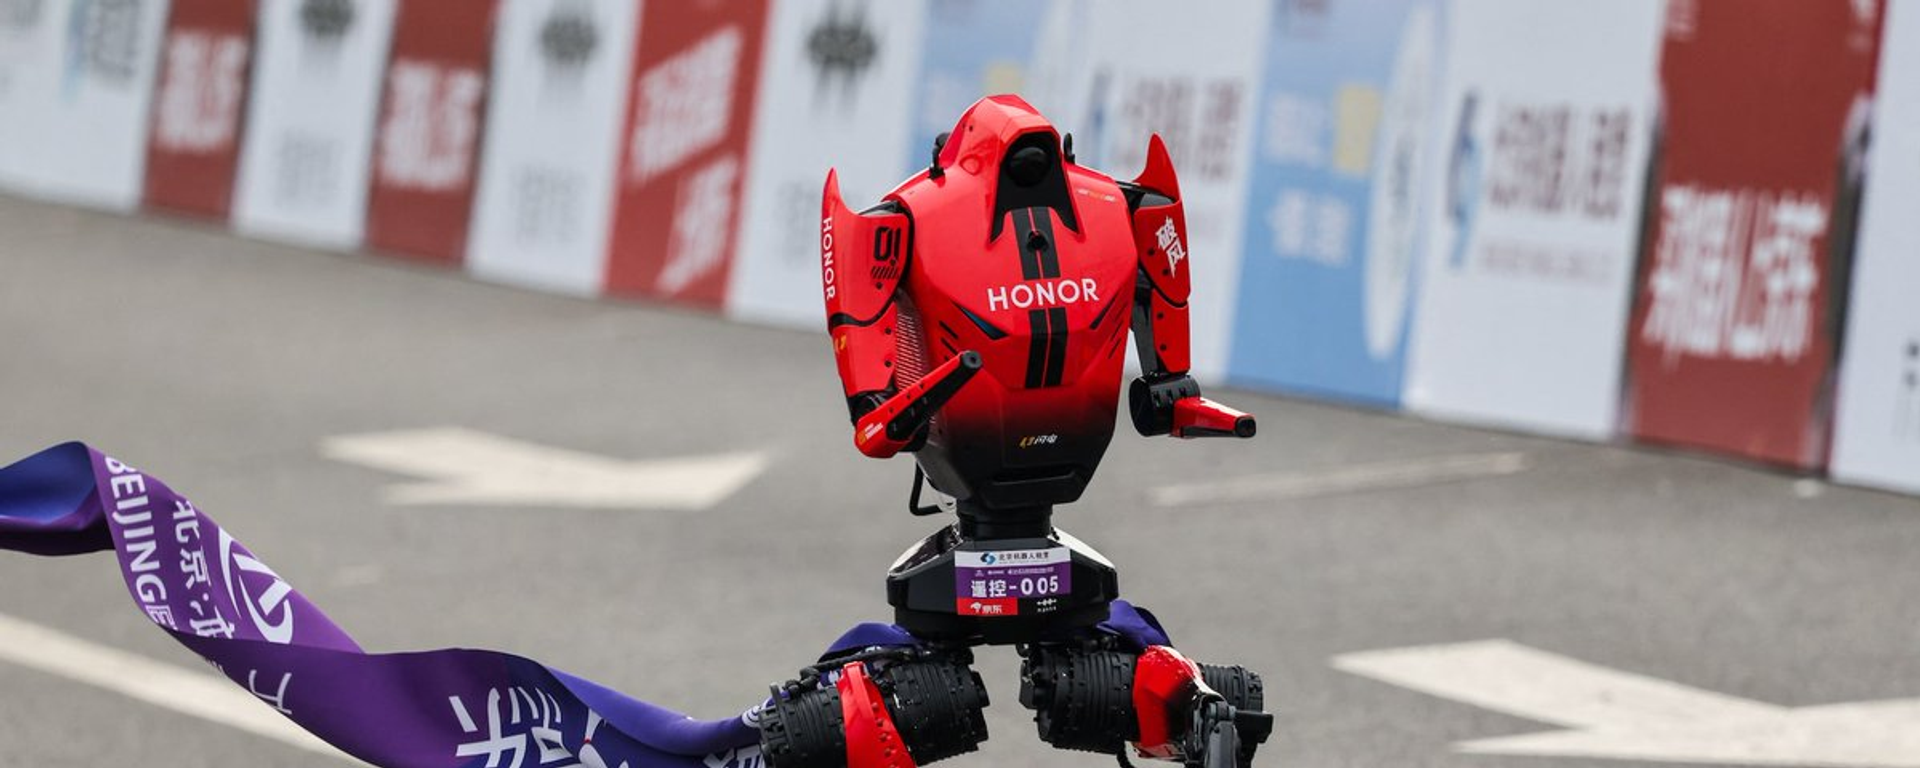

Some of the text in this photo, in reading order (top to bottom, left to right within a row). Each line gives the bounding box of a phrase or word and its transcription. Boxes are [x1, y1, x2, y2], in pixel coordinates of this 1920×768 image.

[822, 217, 836, 300] HONOR
[873, 226, 902, 262] 01
[1155, 215, 1187, 278] 破风
[987, 277, 1100, 312] HONOR
[970, 576, 1059, 598] 遥控-005
